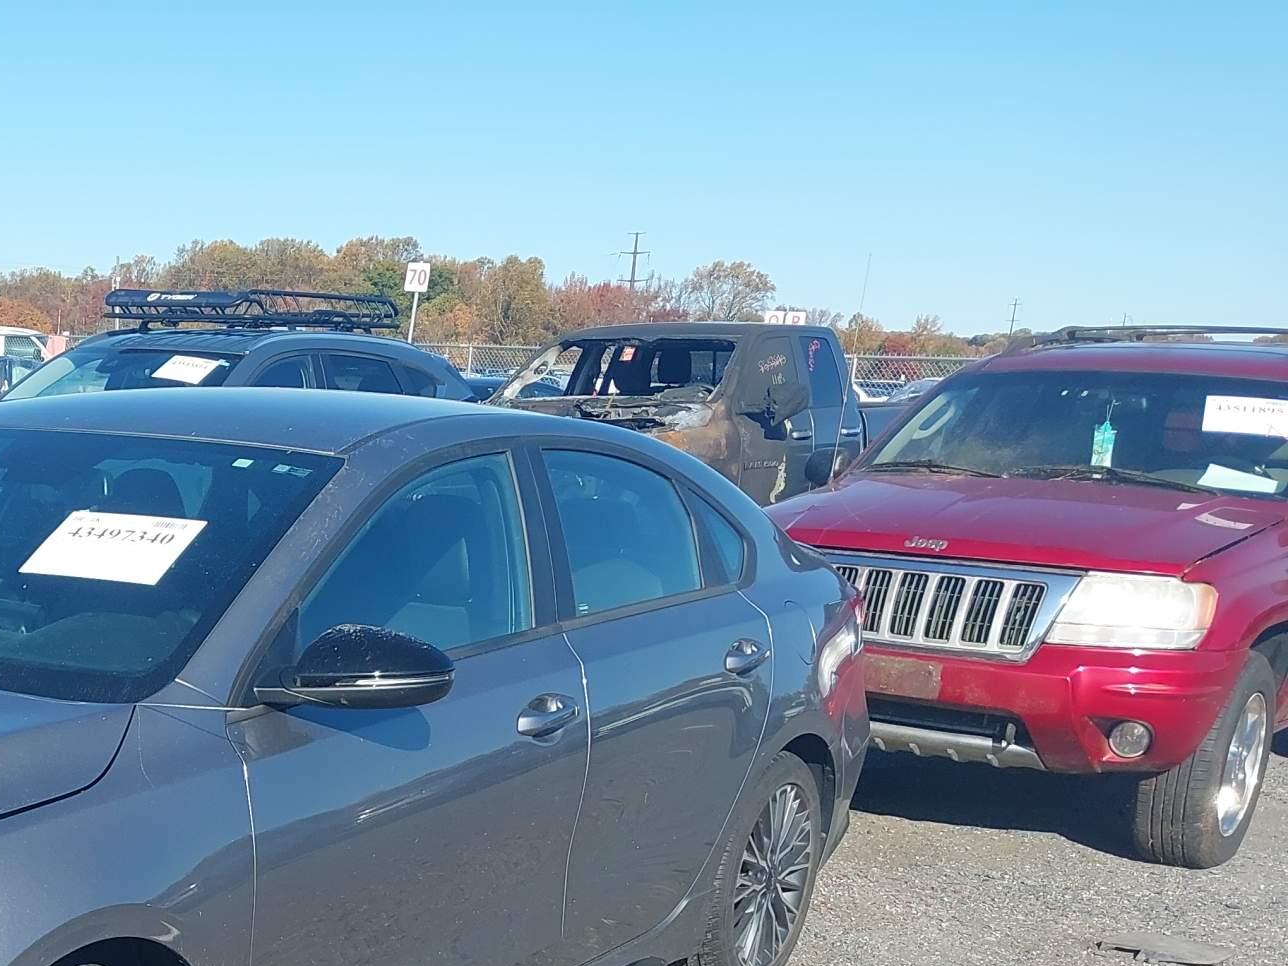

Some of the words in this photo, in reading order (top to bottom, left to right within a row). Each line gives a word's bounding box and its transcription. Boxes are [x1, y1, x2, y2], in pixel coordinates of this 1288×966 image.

[408, 269, 427, 286] 70
[67, 526, 176, 545] 43497340
[904, 536, 949, 552] Jeep
